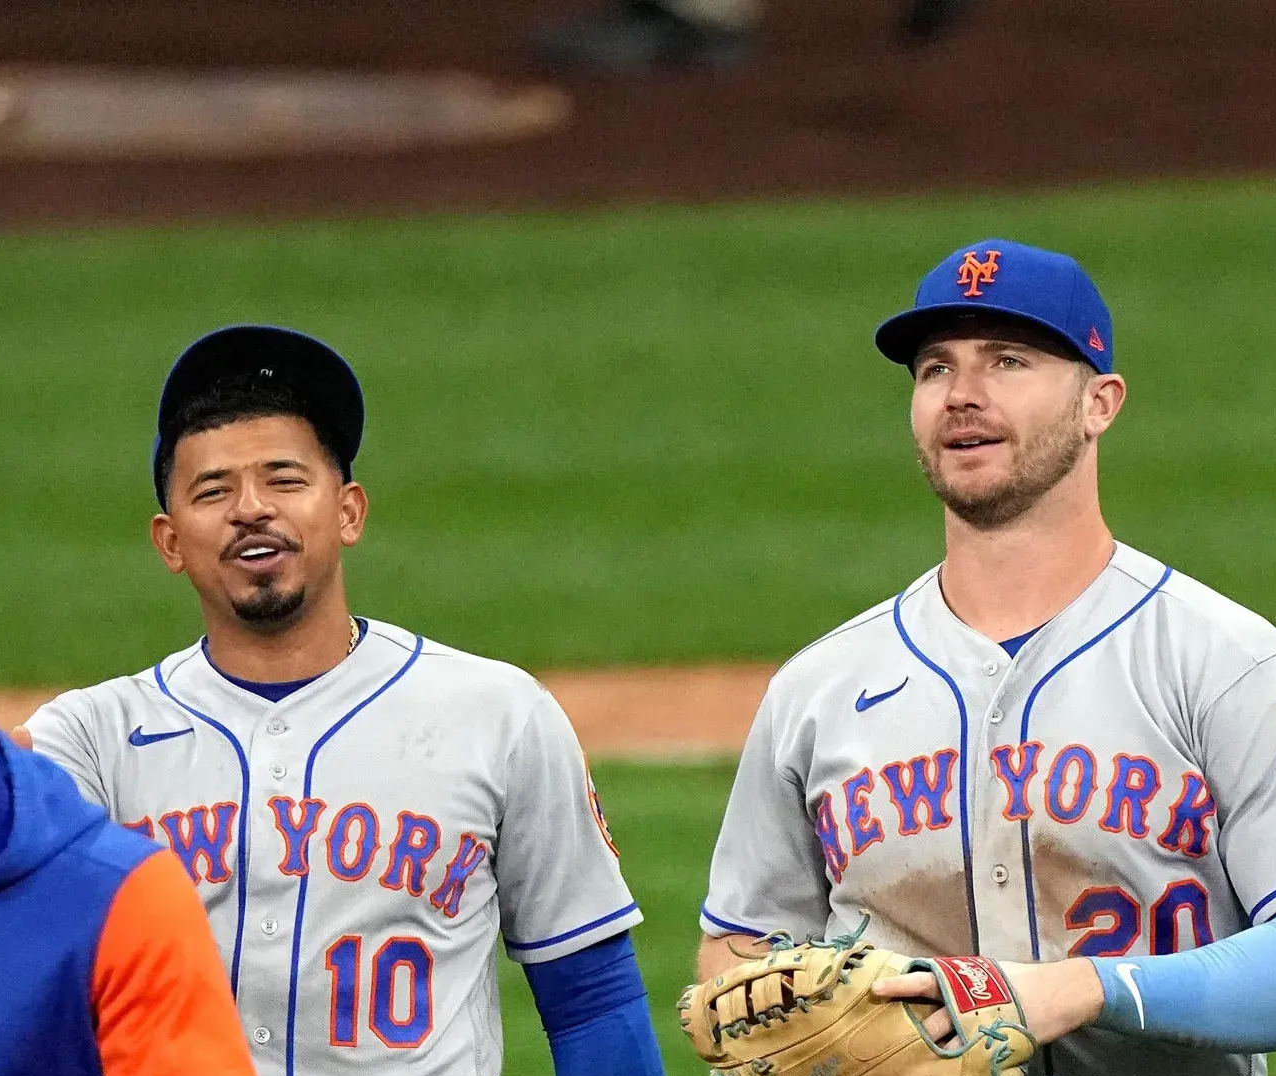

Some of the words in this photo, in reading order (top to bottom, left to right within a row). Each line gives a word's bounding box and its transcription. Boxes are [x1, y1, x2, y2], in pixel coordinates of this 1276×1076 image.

[267, 796, 487, 919] YORK
[814, 747, 960, 884] NEW
[990, 740, 1218, 860] YORK
[325, 934, 434, 1049] 10
